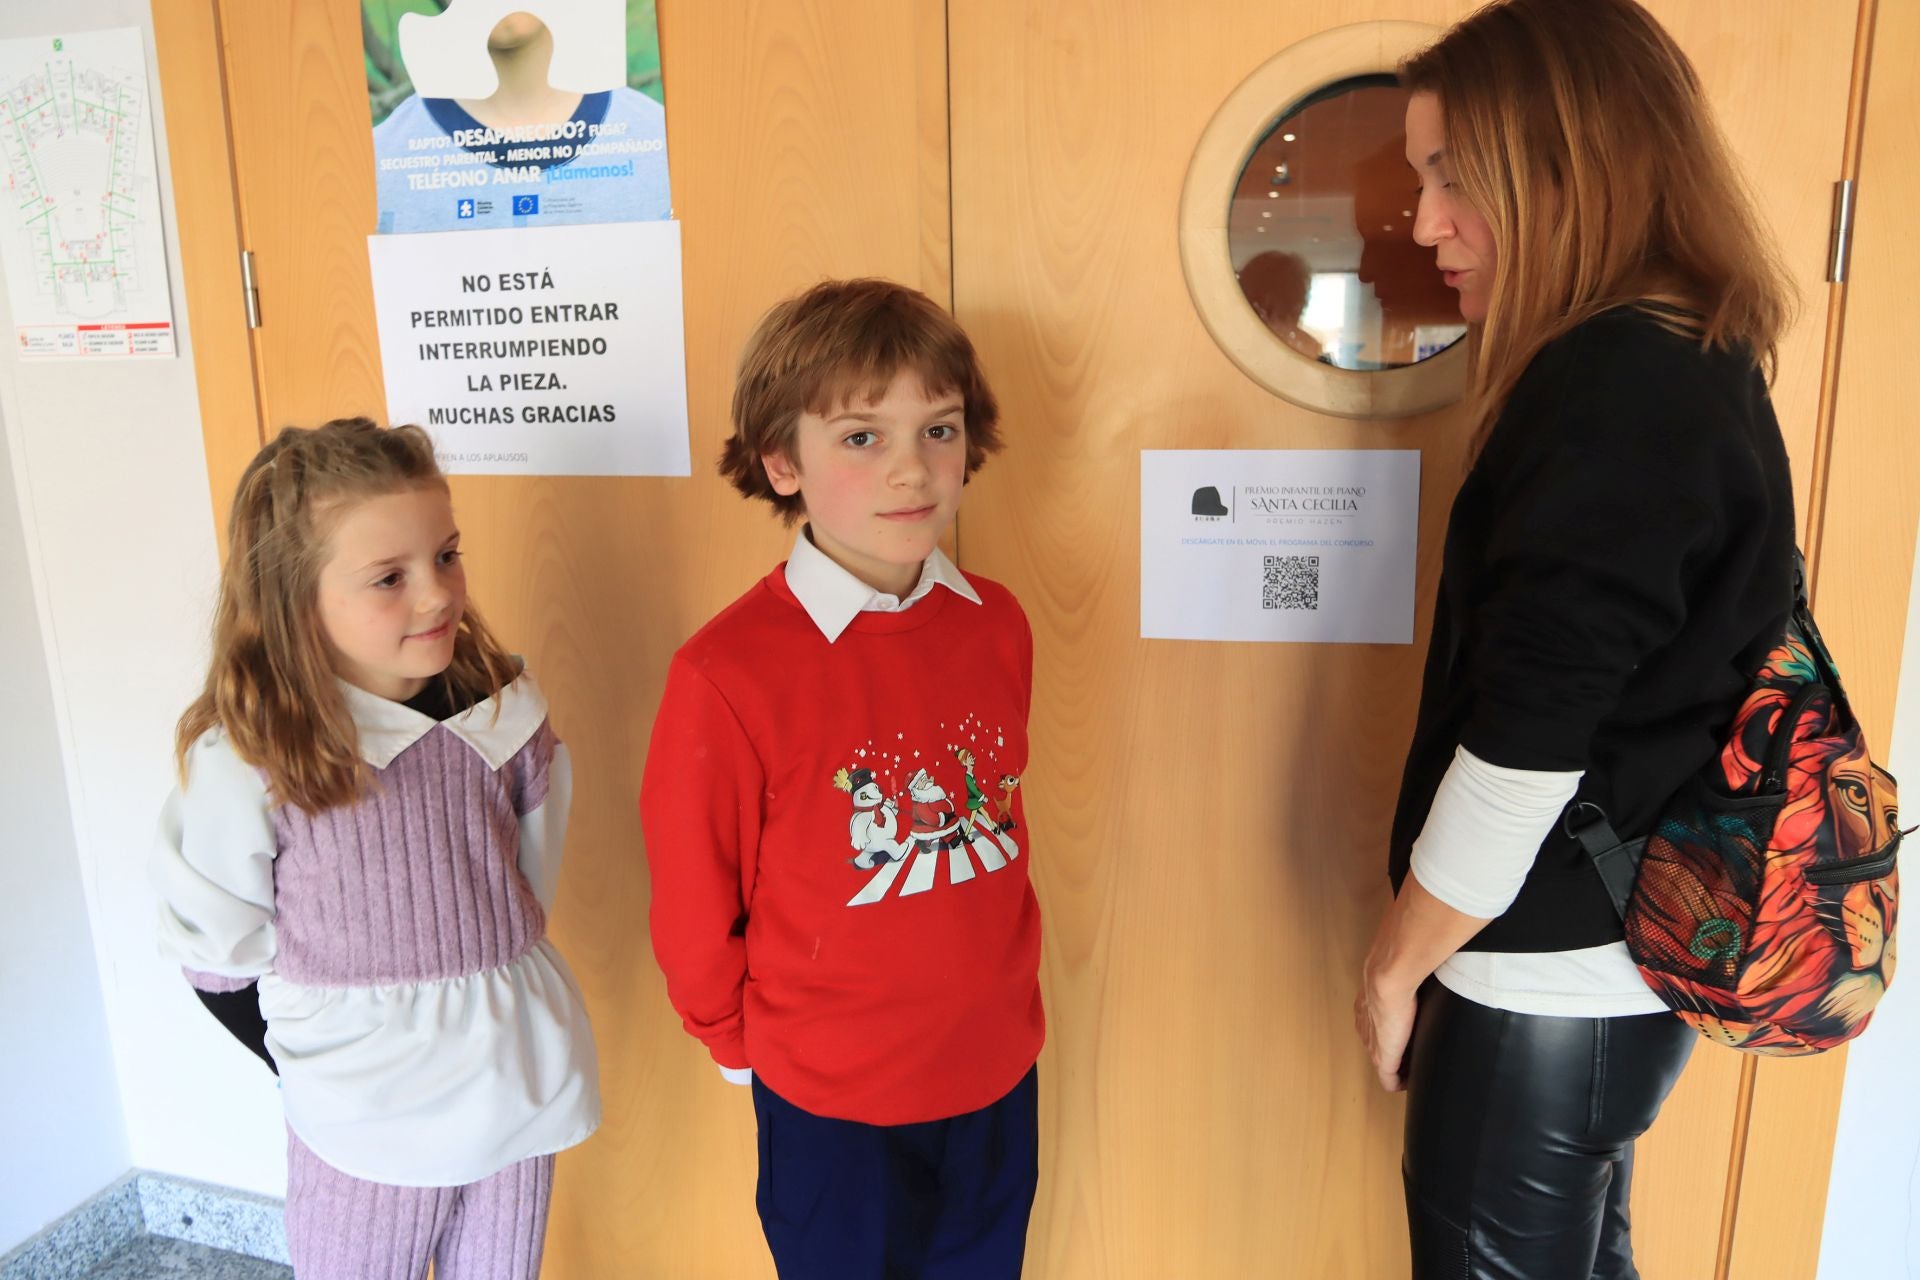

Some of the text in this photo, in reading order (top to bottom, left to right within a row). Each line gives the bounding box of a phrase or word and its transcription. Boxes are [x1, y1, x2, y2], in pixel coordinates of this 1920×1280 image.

[408, 120, 628, 151] RAPTO? DESAPARECIDO? FUGA?
[380, 155, 440, 171] SECUESTRO
[443, 151, 498, 166] PARENTAL
[507, 144, 550, 162] MENOR
[553, 144, 573, 158] NO
[575, 137, 663, 156] ACOMPAÑADO
[408, 168, 488, 190] TELÉFONO
[492, 165, 541, 185] ANAR
[462, 267, 554, 293] NO ESTÁ
[411, 302, 619, 328] PERMITIDO ENTRAR
[419, 337, 608, 361] INTERRUMPIENDO
[468, 372, 568, 392] LA PIEZA.
[429, 404, 616, 425] MUCHAS GRACIAS
[466, 452, 481, 463] LOS
[1245, 486, 1366, 498] PREMIO INFANTIL DE PIANO
[1250, 497, 1359, 513] SANTA CECILIA
[1226, 538, 1235, 546] EN
[1237, 538, 1245, 546] EL
[1270, 538, 1278, 546] EL
[1279, 538, 1318, 547] PROGRAMA
[1320, 539, 1333, 547] DEL
[1334, 539, 1375, 548] CONCURSO
